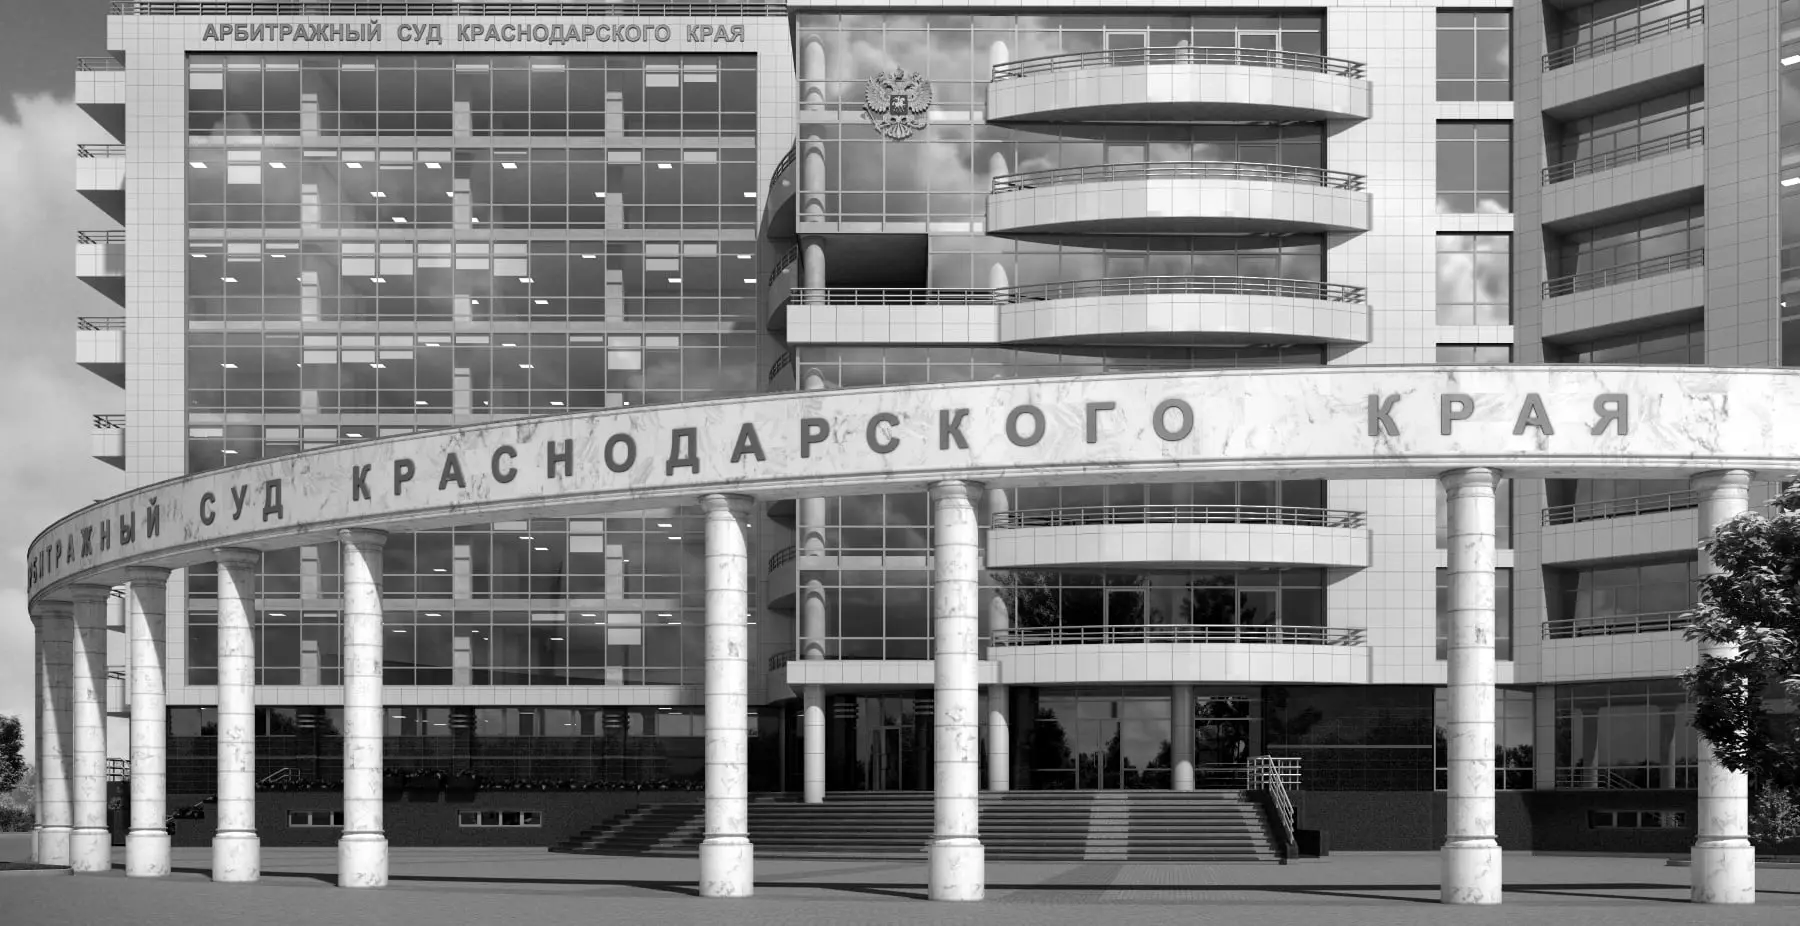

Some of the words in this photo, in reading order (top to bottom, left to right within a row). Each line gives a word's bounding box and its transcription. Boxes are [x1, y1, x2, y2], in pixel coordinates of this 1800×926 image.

[202, 19, 382, 41] АРБИТРАЖНЫЙ
[397, 23, 443, 45] СУД
[457, 23, 672, 45] КРАСНОДАРСКОГО
[686, 24, 745, 43] КРАЯ
[28, 496, 160, 592] РБИТРАЖНЫЙ
[200, 478, 284, 526] СУД
[352, 398, 1195, 501] КРАСНОДАРСКОГО
[1367, 392, 1629, 437] КРАЯ
